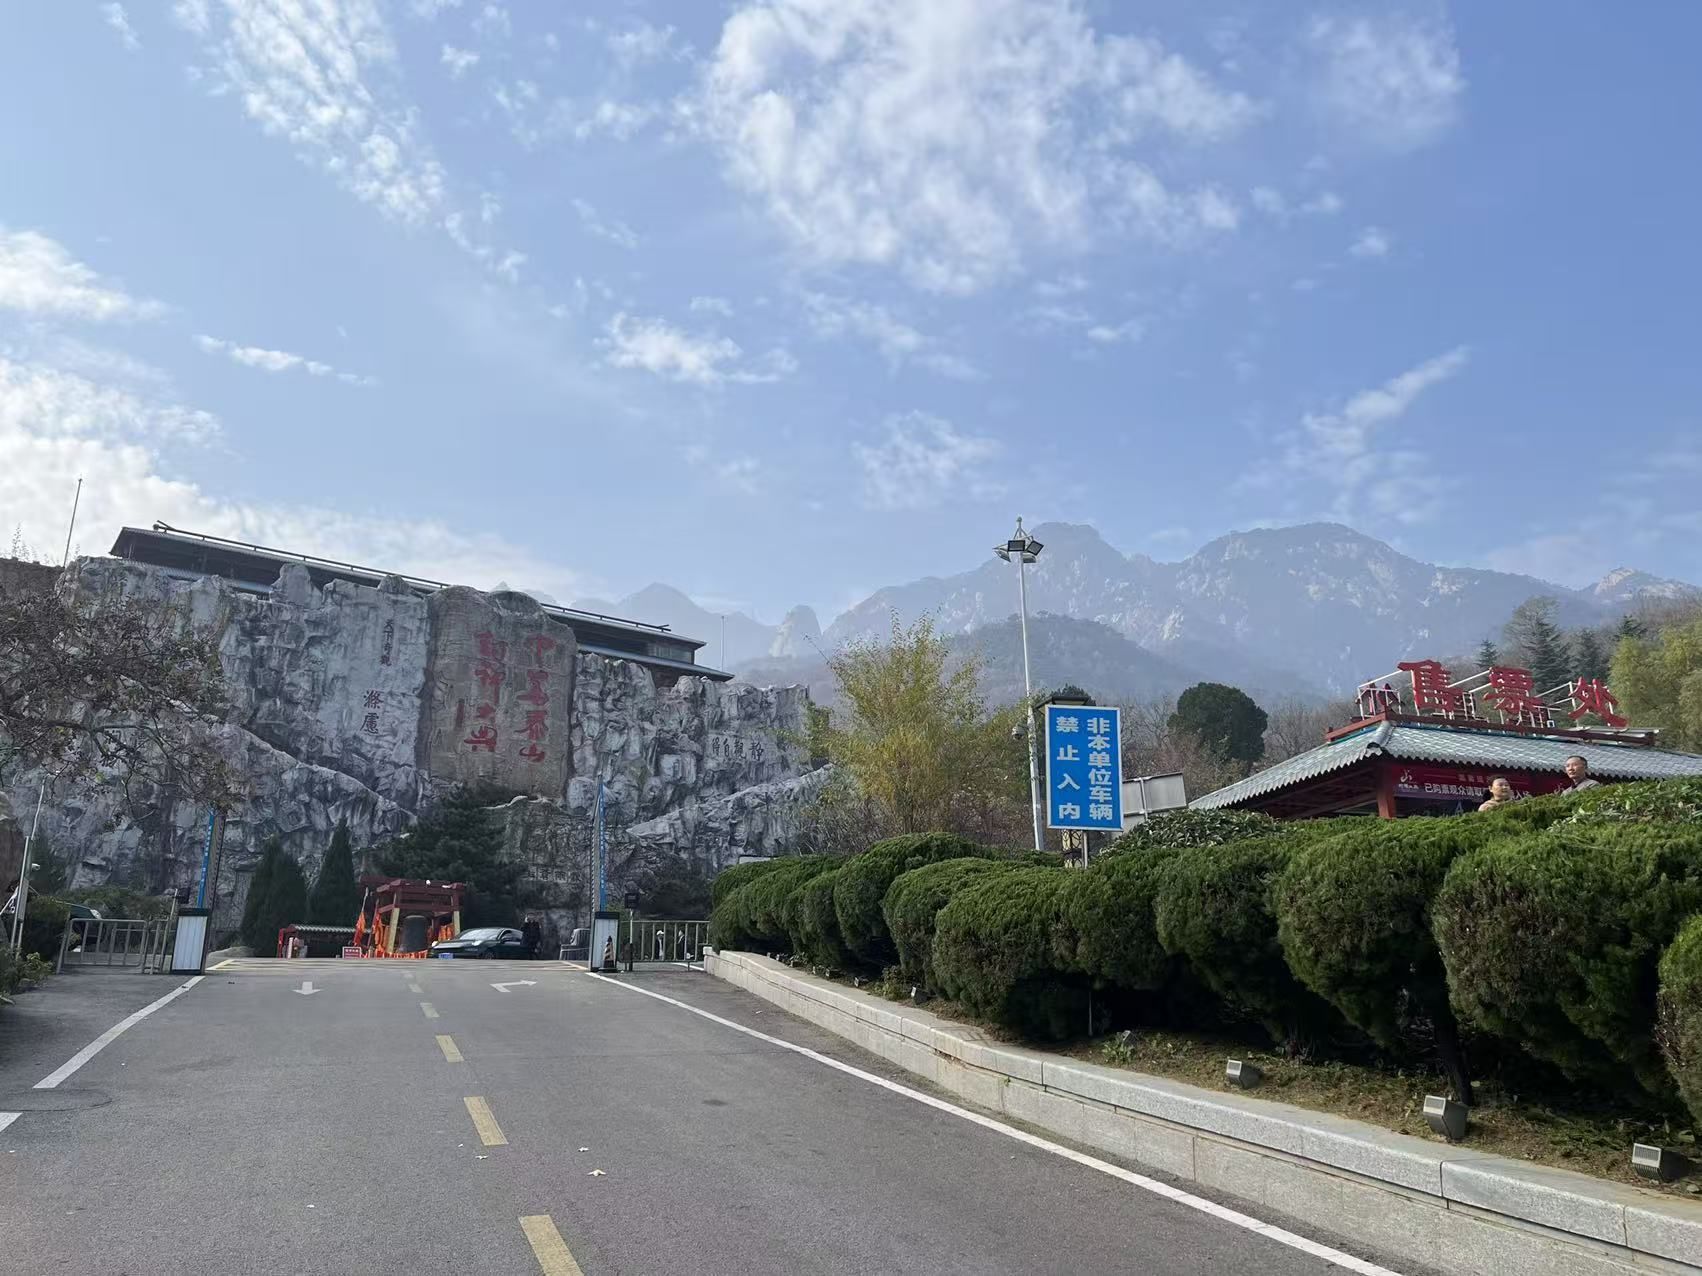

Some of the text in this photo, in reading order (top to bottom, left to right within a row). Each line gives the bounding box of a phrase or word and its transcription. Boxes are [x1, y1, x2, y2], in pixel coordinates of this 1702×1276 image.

[1056, 716, 1080, 820] 禁止入内
[1086, 717, 1113, 821] 非本单位车辆
